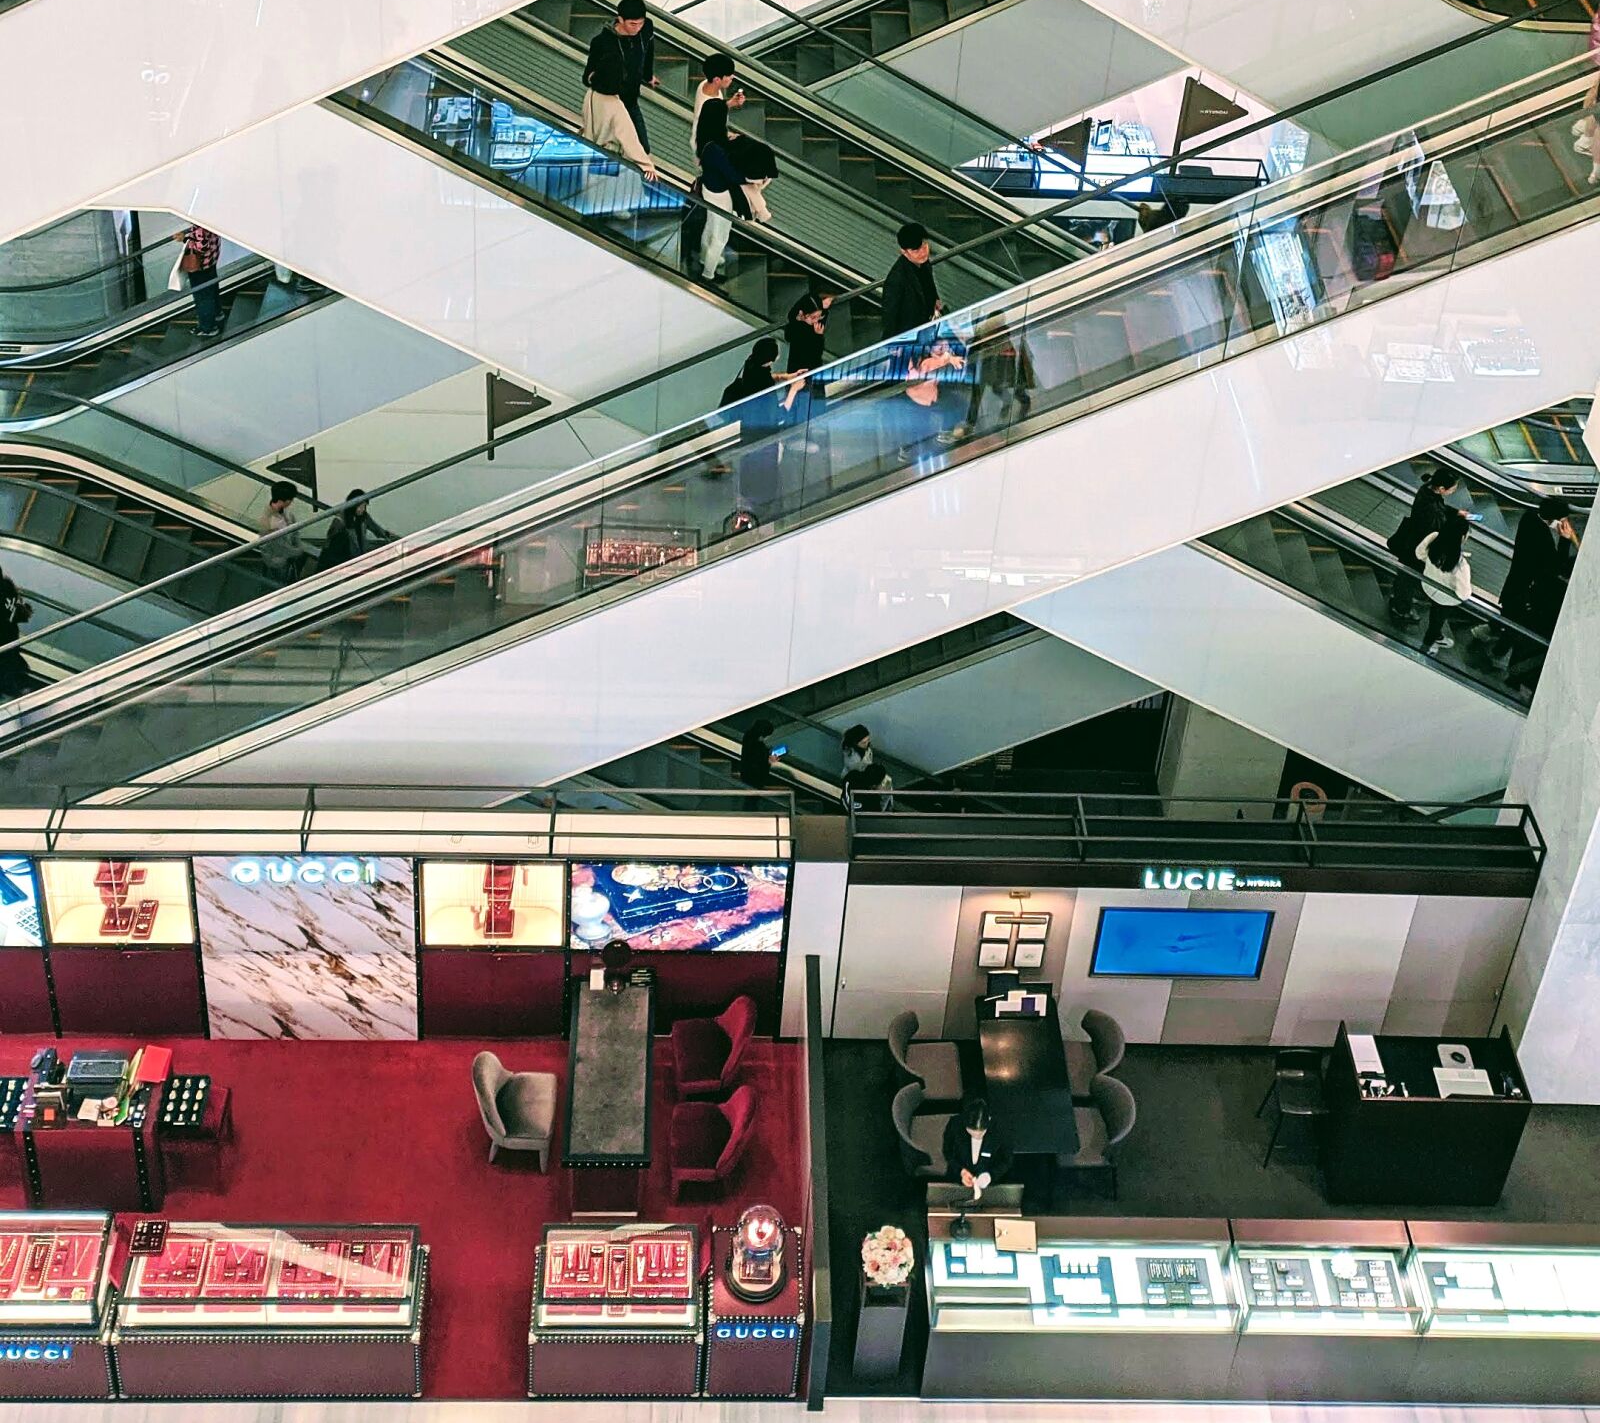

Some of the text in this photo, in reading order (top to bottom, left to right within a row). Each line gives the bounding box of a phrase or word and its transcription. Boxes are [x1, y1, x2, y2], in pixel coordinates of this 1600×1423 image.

[231, 861, 376, 886] GUCCI
[1144, 870, 1235, 891] LUCIE
[716, 1327, 796, 1339] GUCCI
